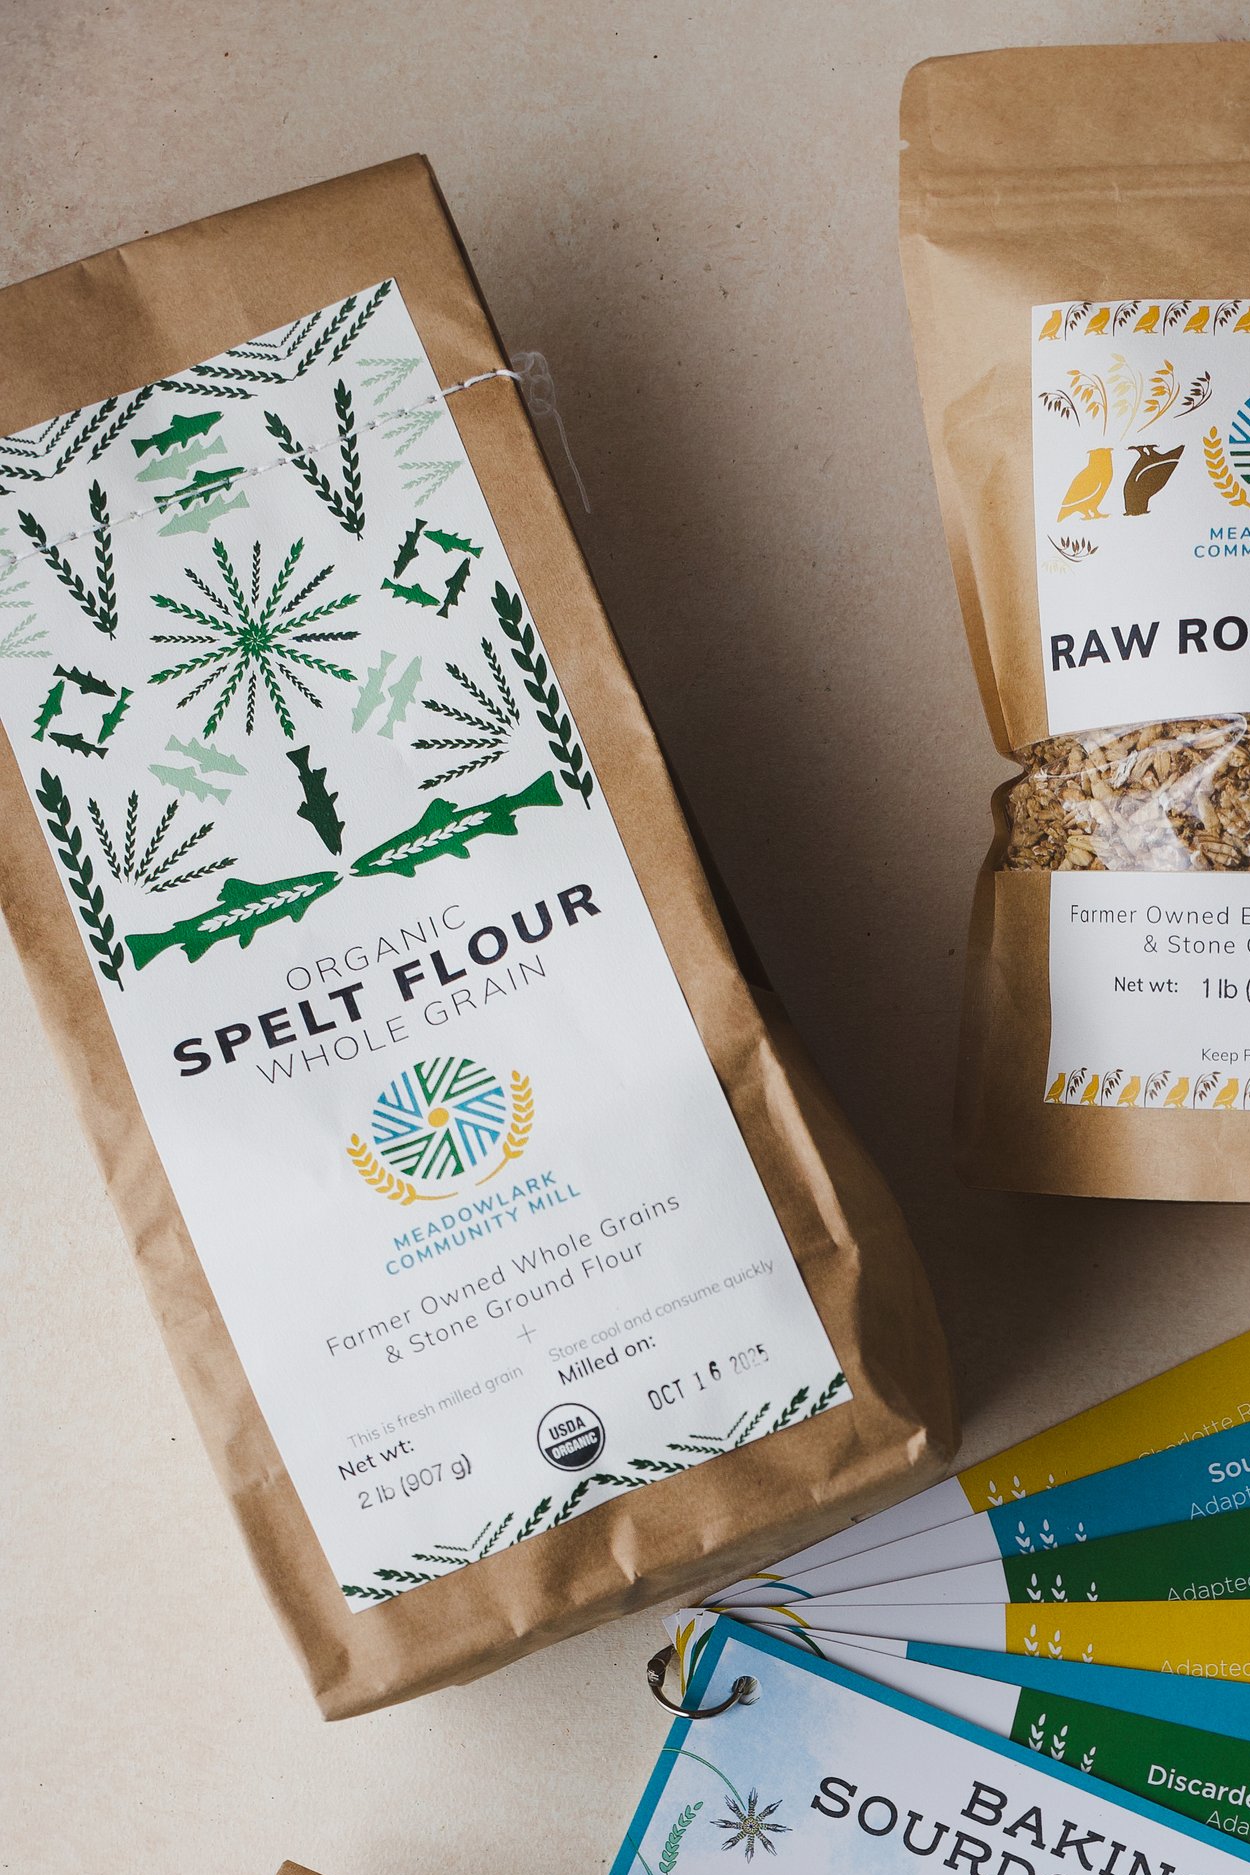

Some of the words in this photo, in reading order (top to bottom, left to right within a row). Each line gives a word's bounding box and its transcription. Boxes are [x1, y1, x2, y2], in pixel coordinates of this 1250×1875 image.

[1051, 621, 1159, 671] RAW
[286, 905, 465, 991] ORGANIC
[1071, 905, 1137, 923] Farmer
[1147, 905, 1229, 925] Owned
[1144, 935, 1157, 953] &
[1168, 935, 1235, 954] Stone
[173, 982, 364, 1077] SPELT
[392, 884, 602, 997] FLOUR
[1115, 977, 1143, 992] Net
[1149, 979, 1178, 993] wt:
[1203, 978, 1209, 998] 1
[1219, 978, 1238, 999] lb
[256, 1015, 409, 1084] WHOLE
[424, 954, 546, 1026] GRAIN
[1202, 1048, 1238, 1065] Keep
[386, 1207, 517, 1275] COMMUNITY
[528, 1184, 581, 1214] MILL
[393, 1170, 557, 1251] MEADOWLARK
[326, 1310, 410, 1356] Farmer
[421, 1265, 506, 1314] Owned
[511, 1234, 592, 1274] Whole
[600, 1197, 679, 1237] Grains
[648, 1379, 684, 1410] OCT
[729, 1344, 769, 1374] 2025
